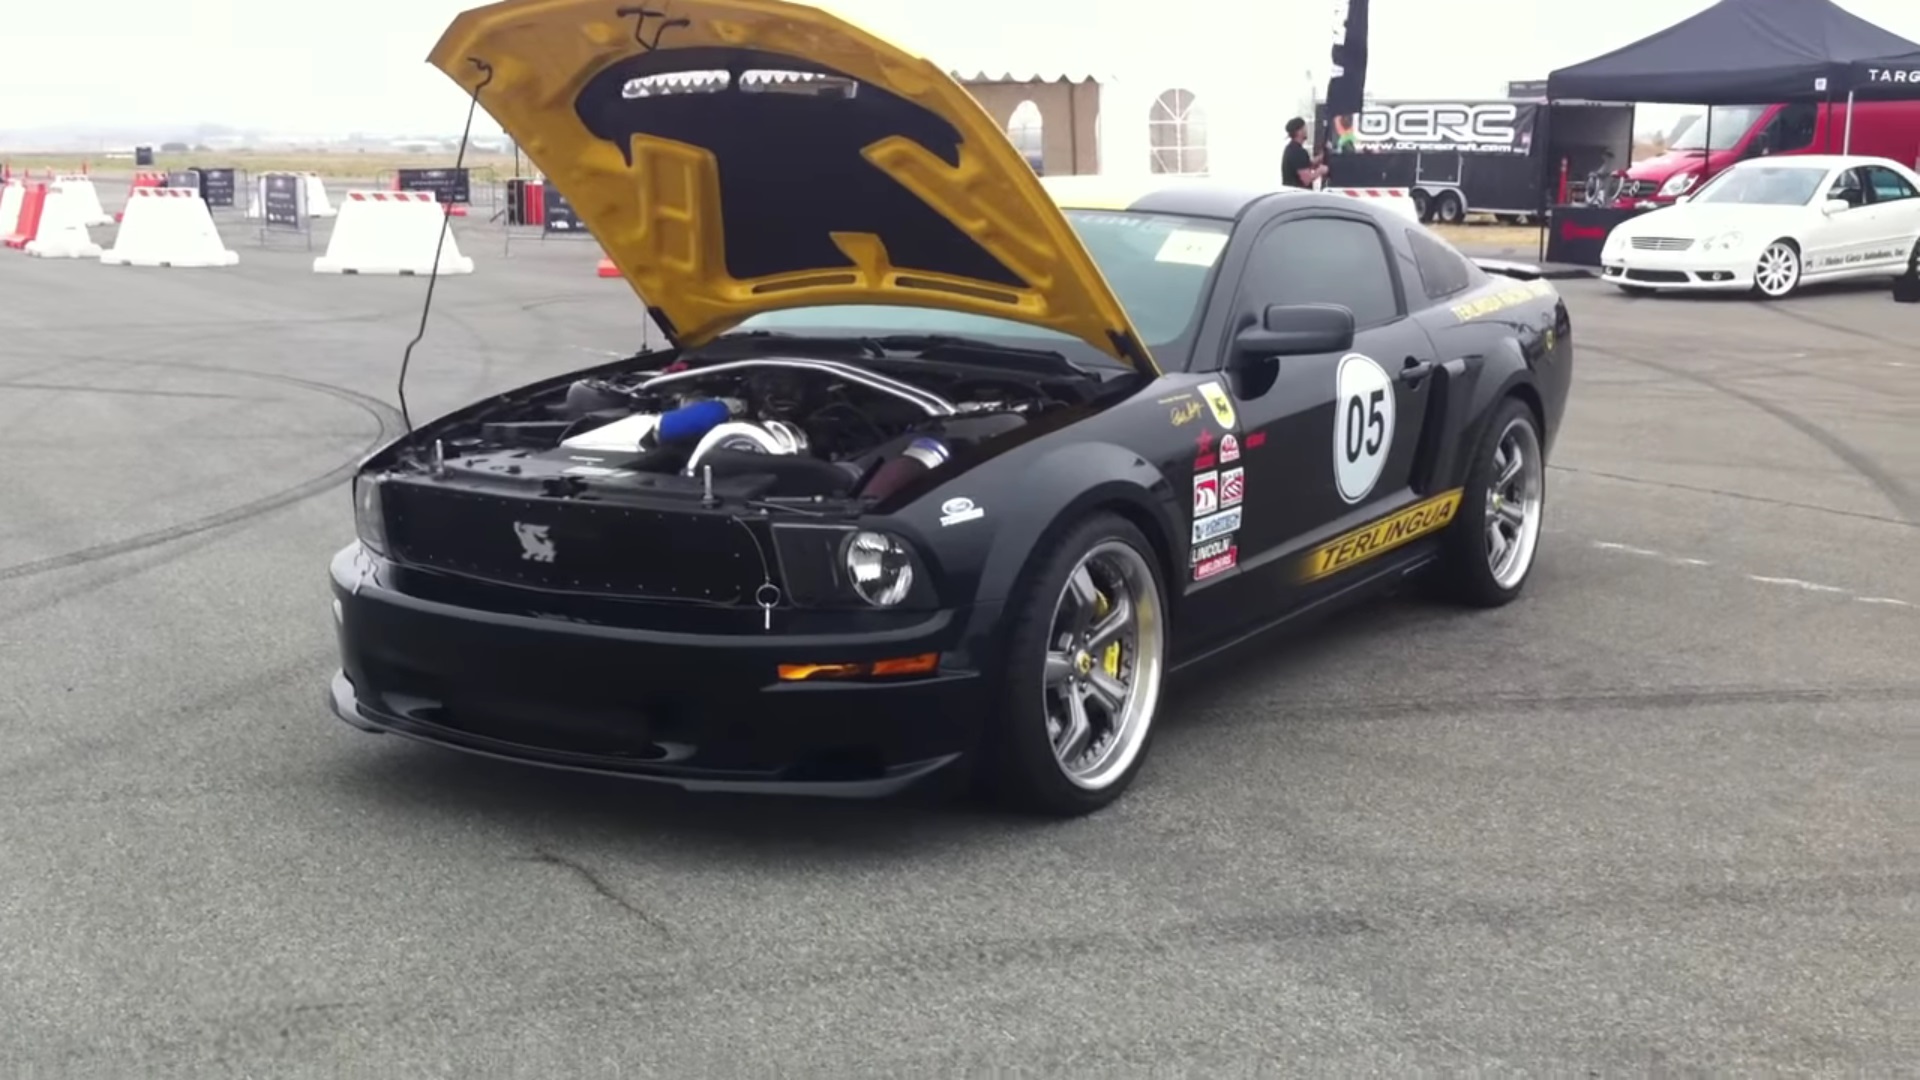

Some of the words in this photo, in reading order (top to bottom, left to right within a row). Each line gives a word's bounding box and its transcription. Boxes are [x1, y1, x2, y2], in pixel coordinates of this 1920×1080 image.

[1346, 389, 1384, 464] 05
[1193, 538, 1230, 562] LINCOLN
[1322, 501, 1452, 571] TERLINGUA
